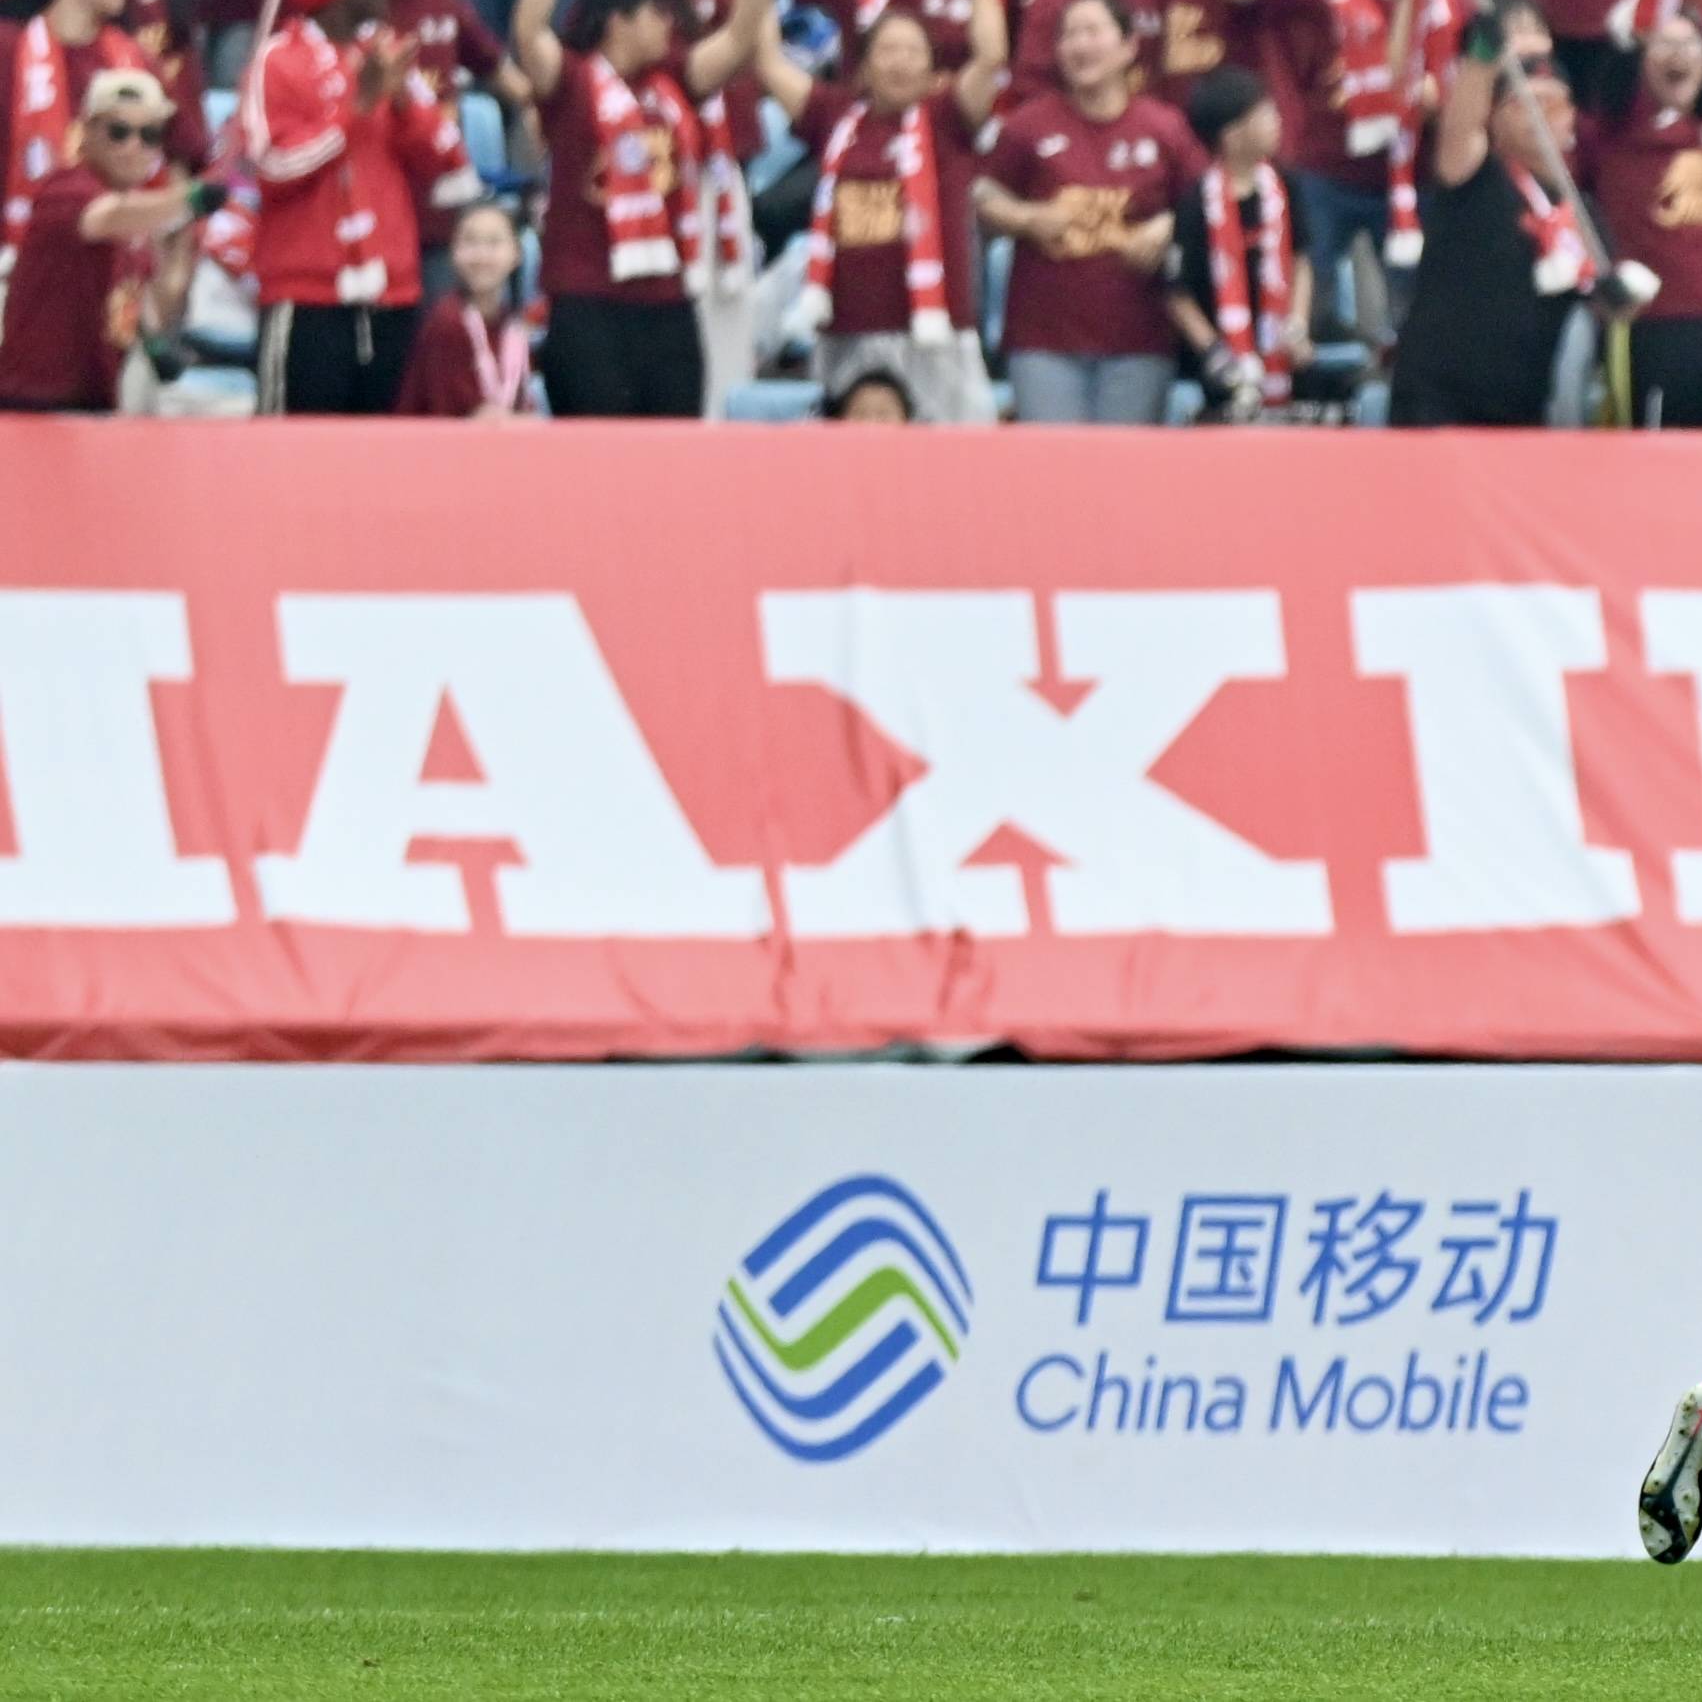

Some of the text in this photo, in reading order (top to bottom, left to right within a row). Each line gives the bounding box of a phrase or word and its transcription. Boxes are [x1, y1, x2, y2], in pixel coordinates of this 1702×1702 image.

[1035, 1189, 1560, 1328] 中国移动
[1014, 1351, 1531, 1434] China Mobile
